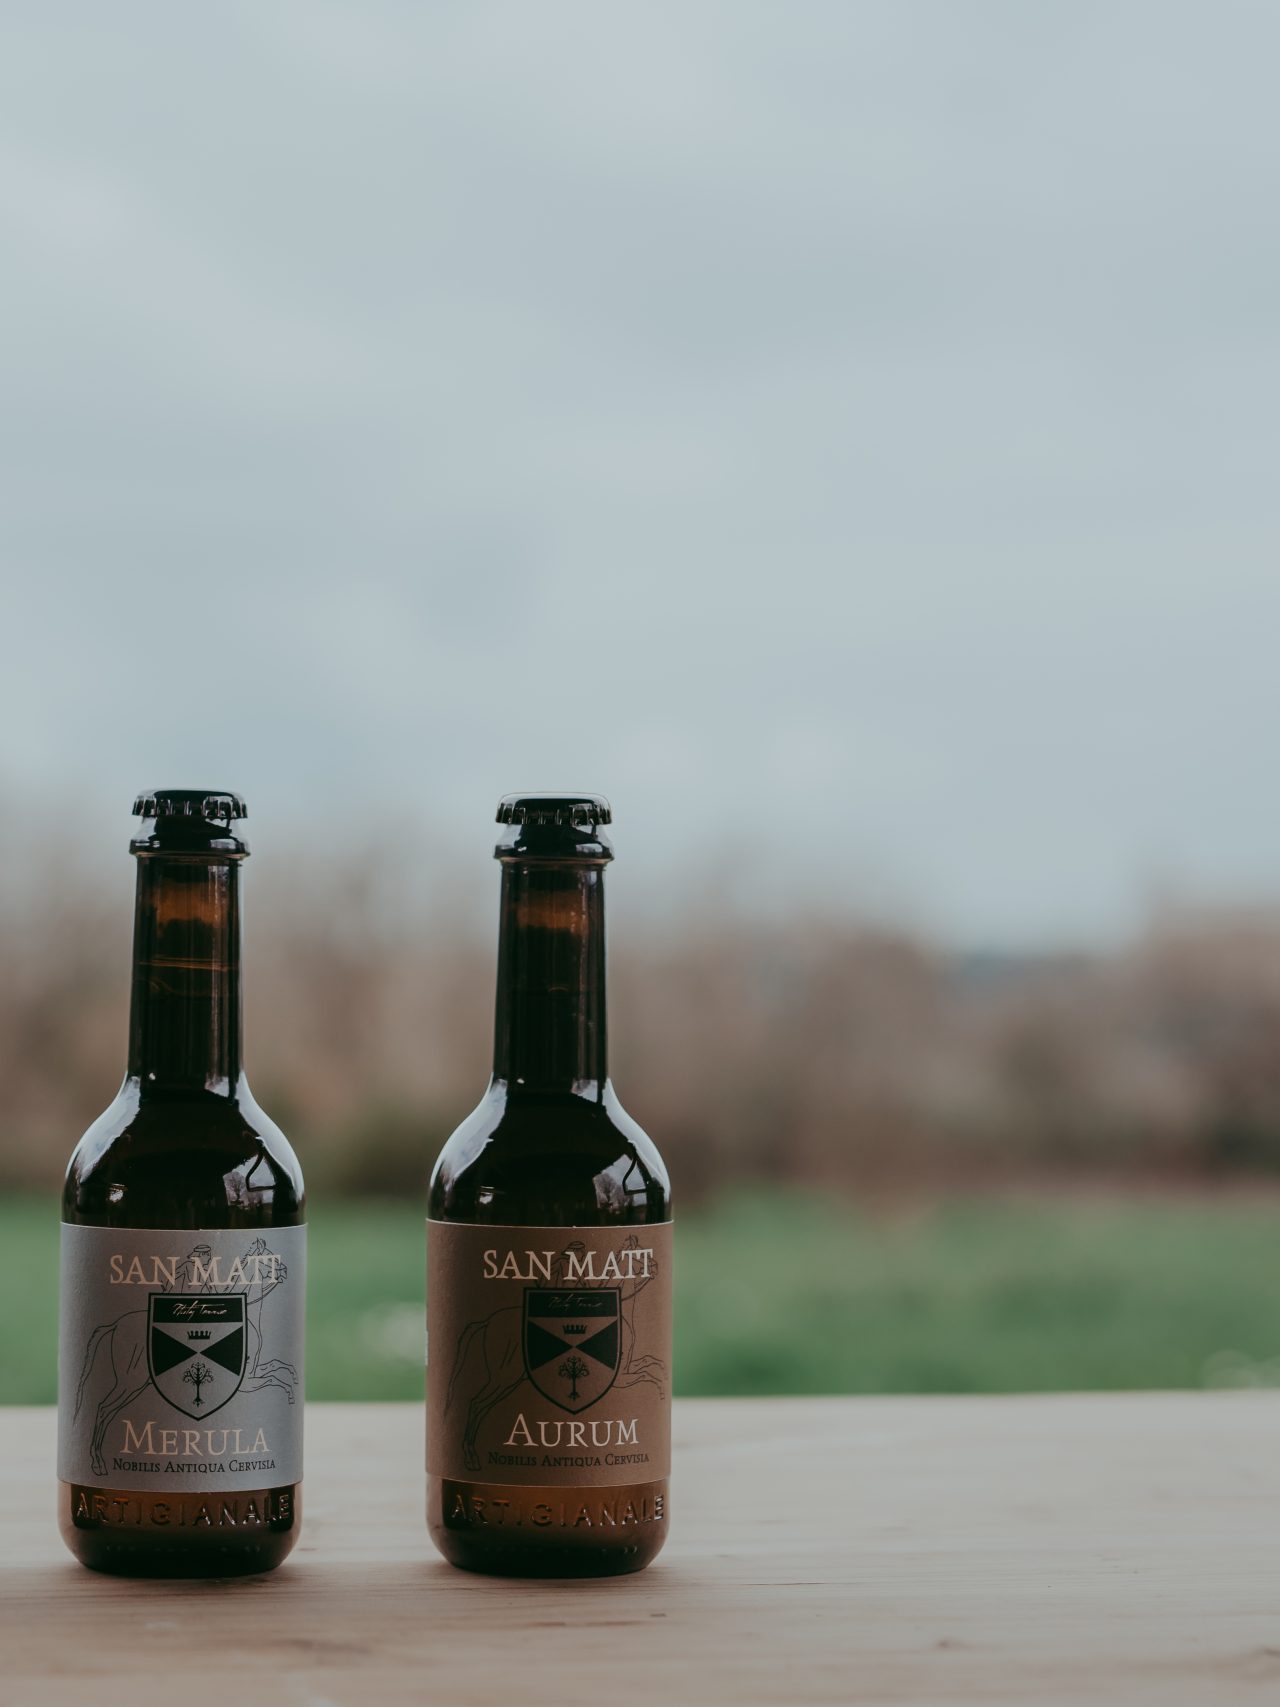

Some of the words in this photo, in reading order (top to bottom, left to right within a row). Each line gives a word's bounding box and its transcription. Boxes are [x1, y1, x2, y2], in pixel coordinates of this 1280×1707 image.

[109, 1254, 180, 1287] SAN
[188, 1254, 282, 1287] MATT
[483, 1249, 555, 1281] SAN
[563, 1248, 654, 1281] MATT
[120, 1419, 271, 1457] MERULA
[503, 1412, 641, 1448] AURUM
[113, 1457, 161, 1473] NOBILIS
[164, 1460, 226, 1475] ANTIQUA
[228, 1458, 277, 1473] CERVISIA
[487, 1451, 537, 1467] NOBILIS
[540, 1454, 602, 1468] ANTIQUA
[604, 1452, 650, 1467] CERVISIA
[76, 1491, 291, 1527] ARTIGIANALE
